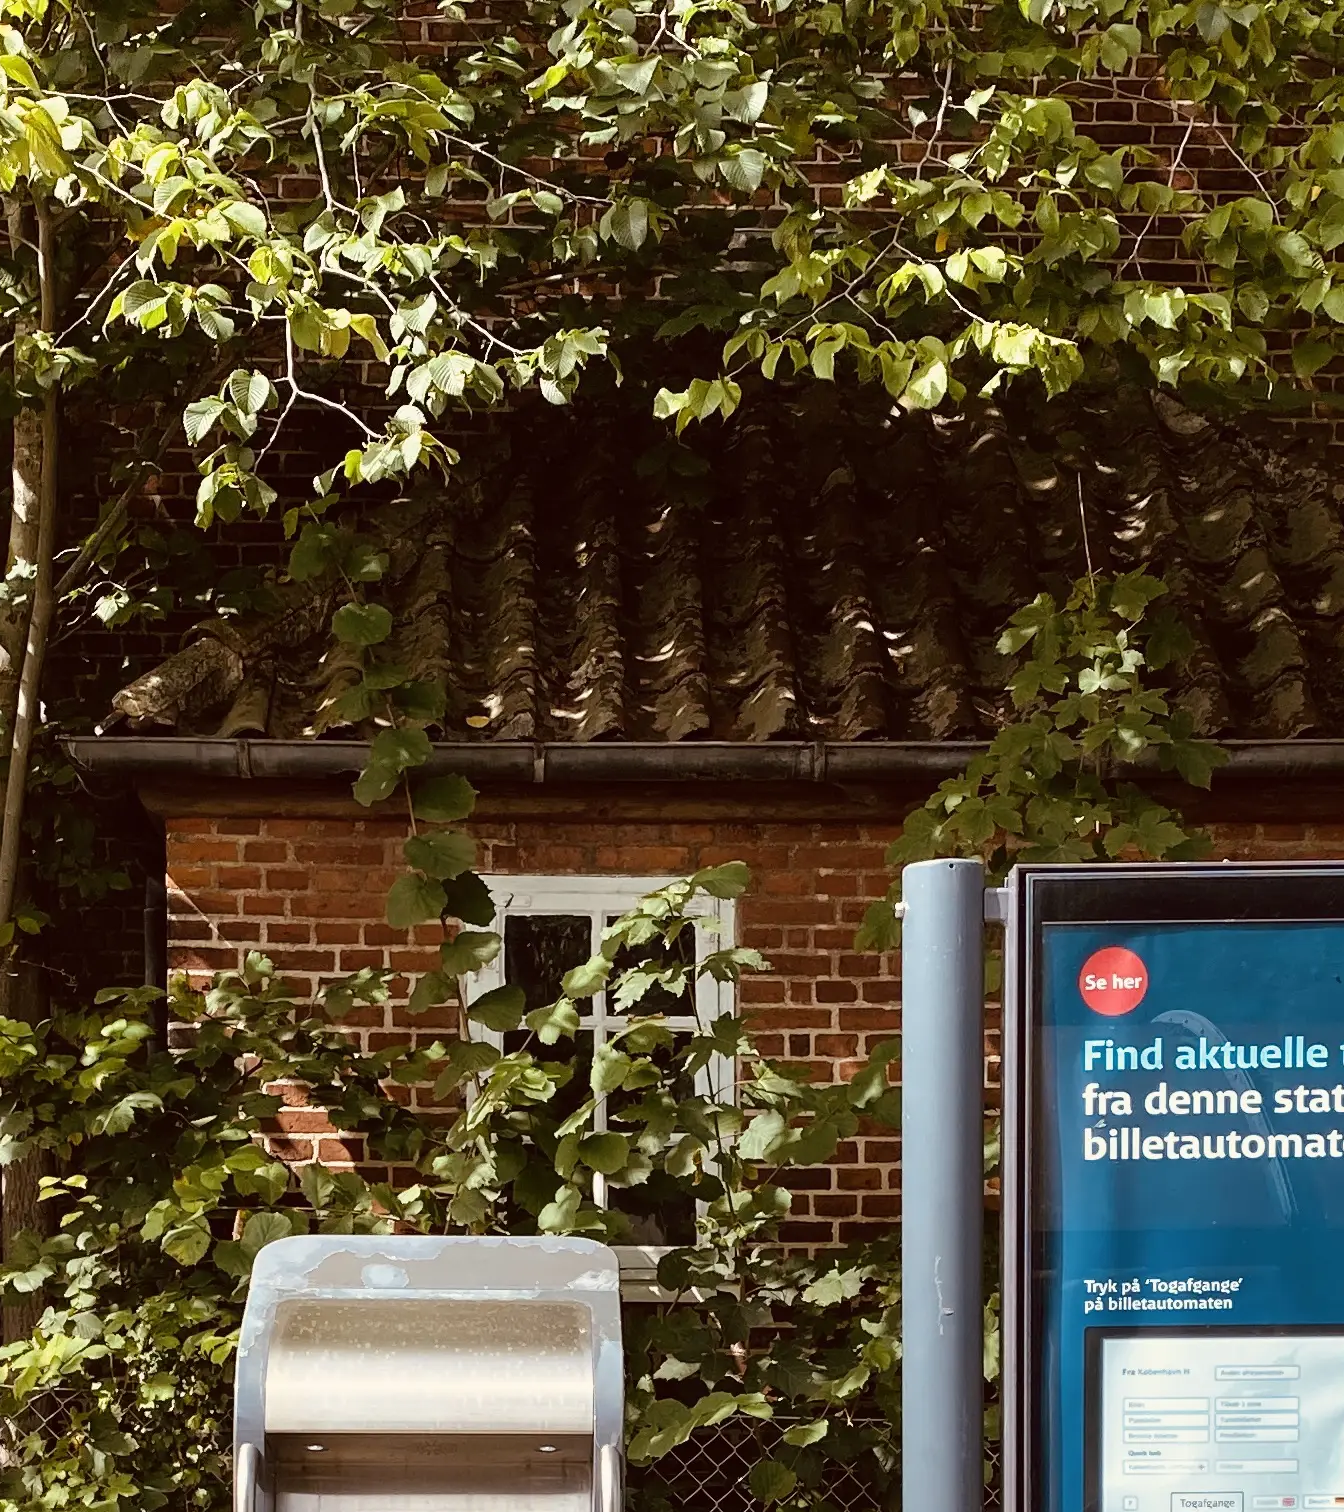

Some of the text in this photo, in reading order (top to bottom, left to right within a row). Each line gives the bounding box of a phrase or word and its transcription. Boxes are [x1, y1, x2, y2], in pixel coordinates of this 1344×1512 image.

[1086, 974, 1142, 990] Se her
[1085, 1038, 1163, 1070] Find
[1176, 1036, 1328, 1069] aktuelle
[1082, 1083, 1132, 1115] fra
[1145, 1083, 1262, 1114] denne
[1084, 1279, 1117, 1296] Tryk
[1122, 1279, 1140, 1295] på
[1085, 1297, 1232, 1314] på billetautomaten
[1180, 1499, 1235, 1508] Togafgange
